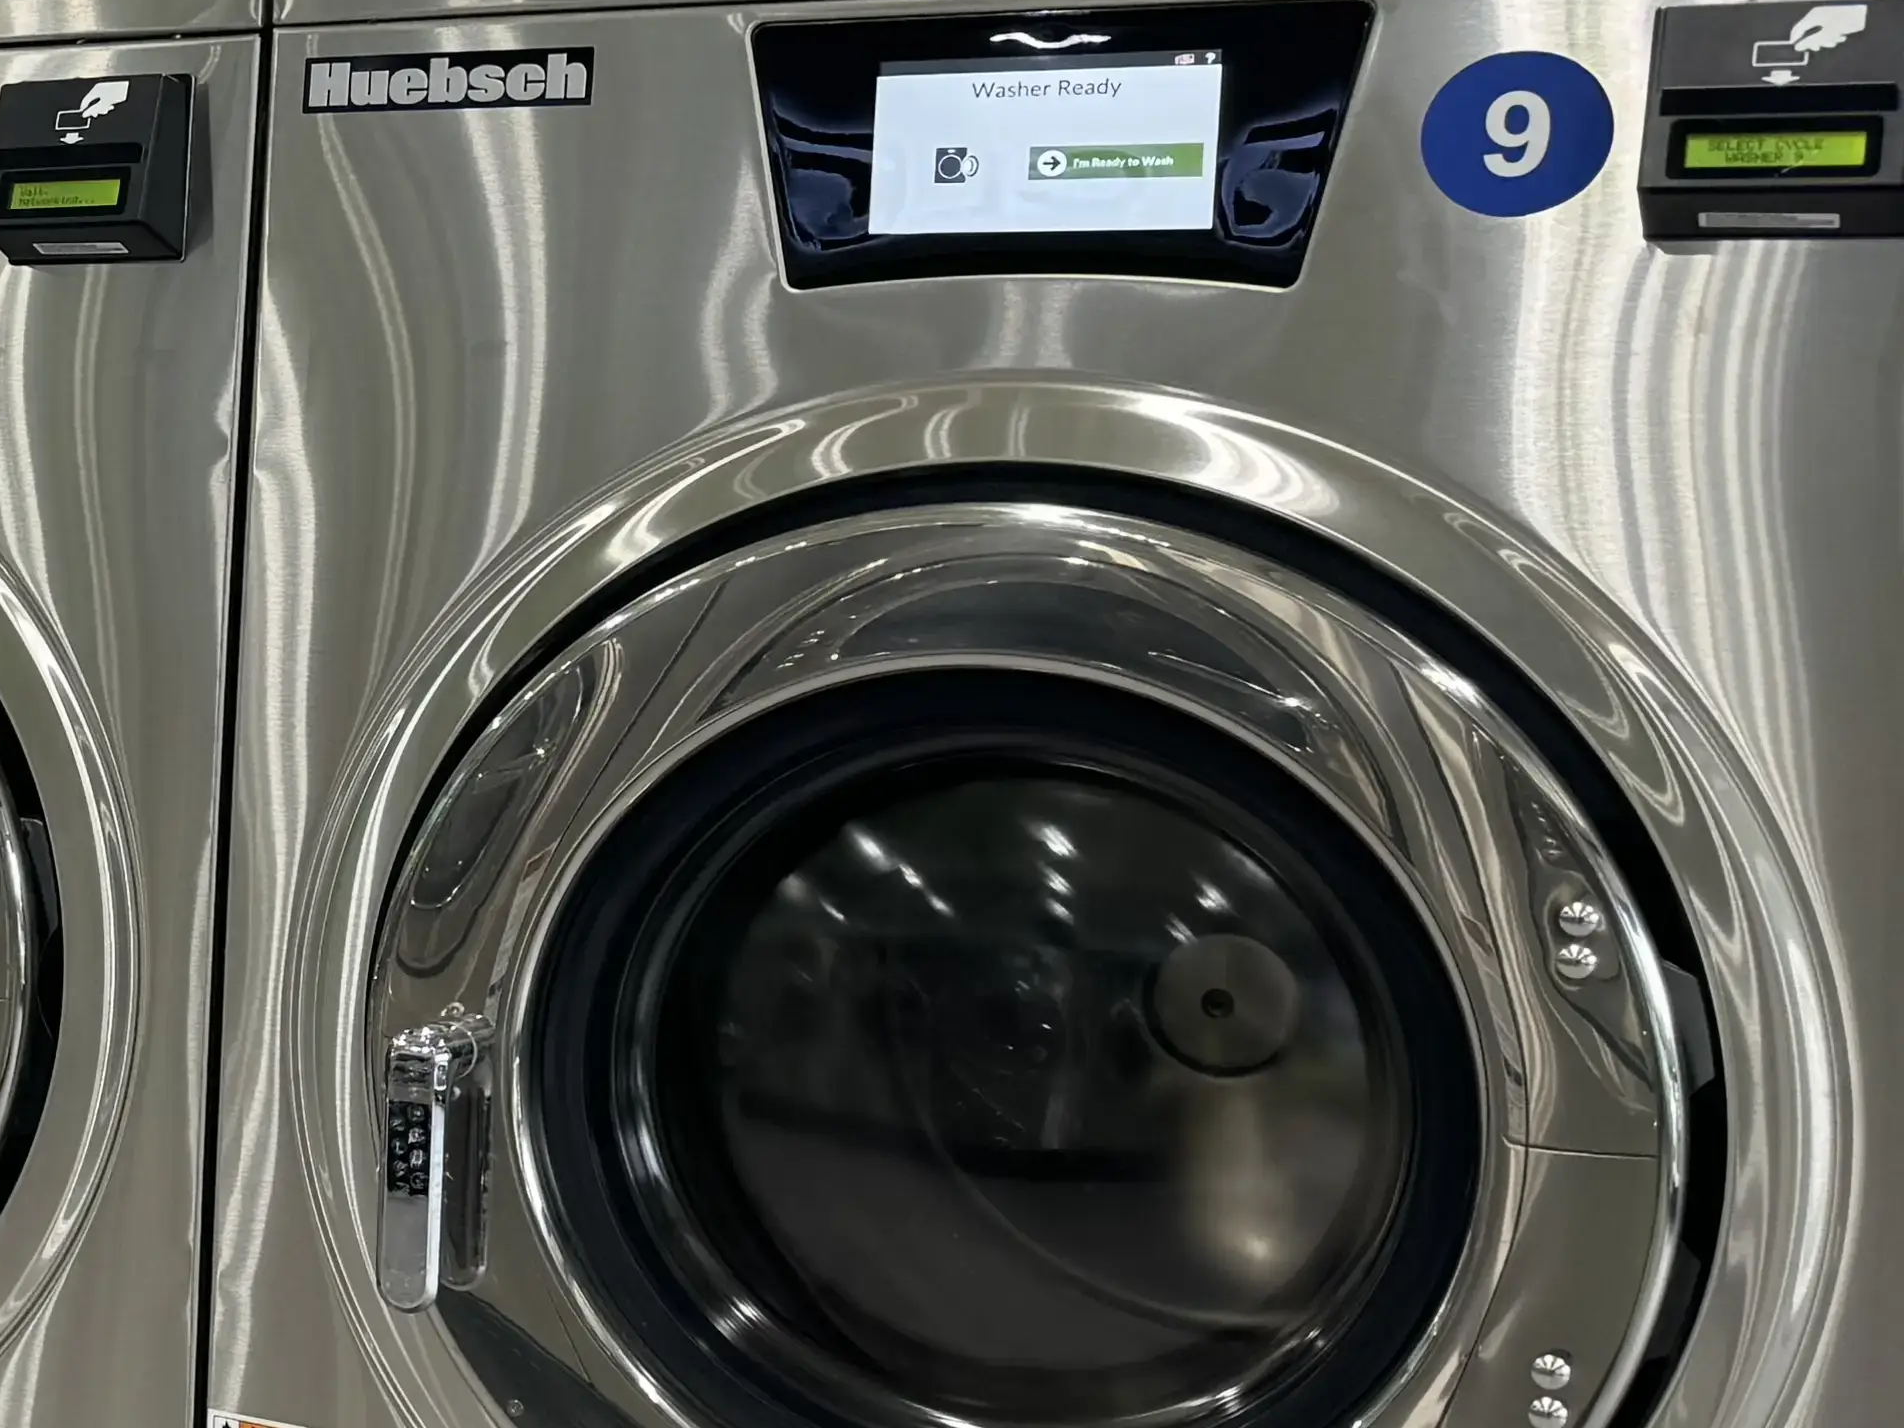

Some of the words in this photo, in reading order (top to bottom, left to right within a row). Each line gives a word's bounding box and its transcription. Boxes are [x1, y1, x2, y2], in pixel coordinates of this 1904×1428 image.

[308, 53, 588, 107] Huebsch
[972, 81, 1051, 99] Washer
[1058, 78, 1122, 98] Ready
[1483, 90, 1551, 178] 9
[1707, 138, 1764, 152] SELECT
[1073, 158, 1090, 169] I'm
[1091, 157, 1126, 169] Ready
[1128, 157, 1140, 167] to
[1141, 156, 1174, 167] Wash
